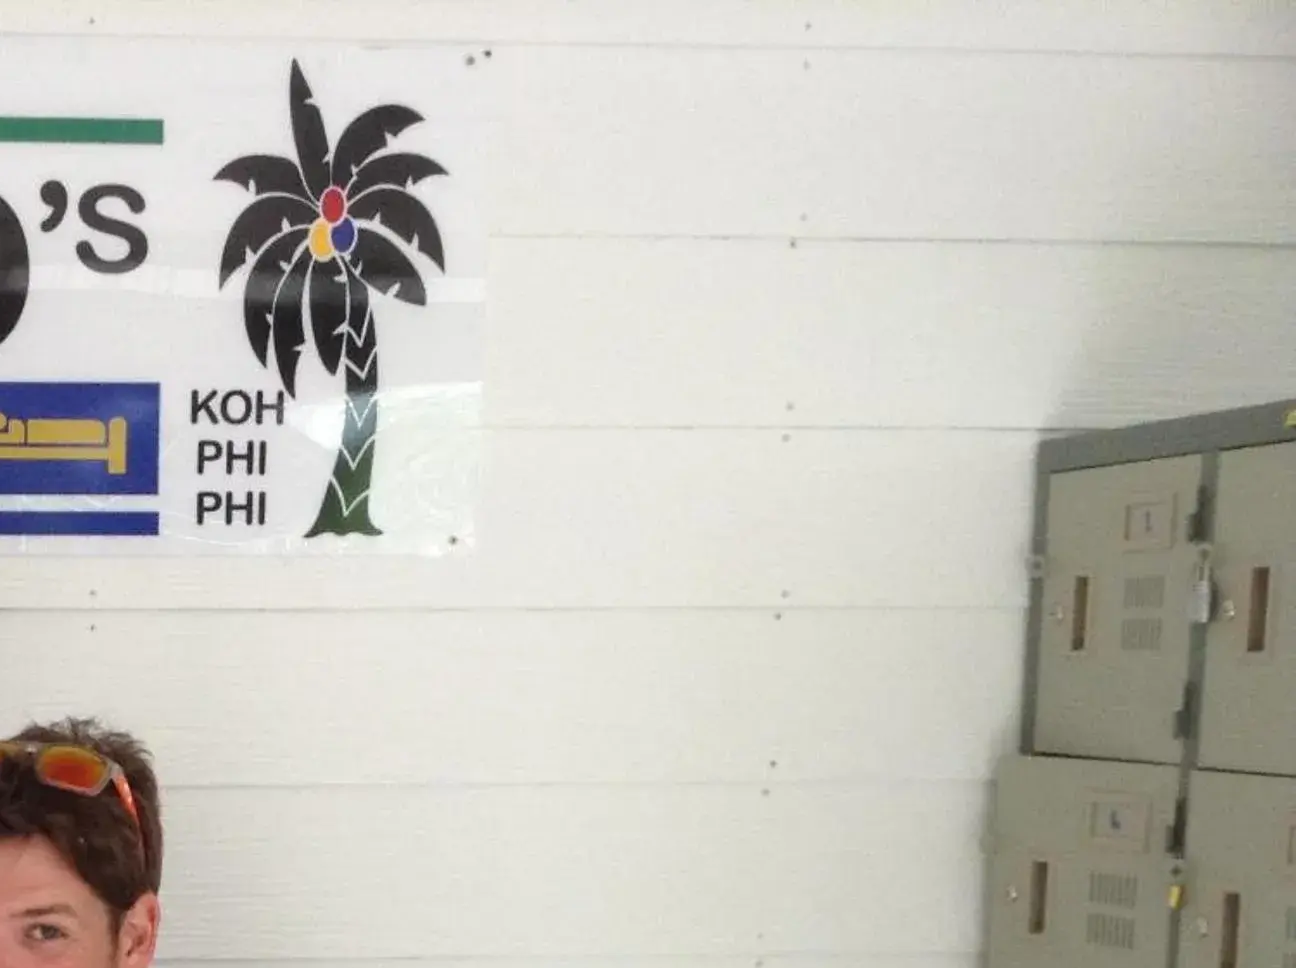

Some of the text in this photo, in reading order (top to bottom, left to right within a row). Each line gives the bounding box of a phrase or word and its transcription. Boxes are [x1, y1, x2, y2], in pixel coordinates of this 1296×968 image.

[191, 390, 284, 424] KOH
[197, 440, 266, 475] PHI
[197, 491, 266, 525] PHI
